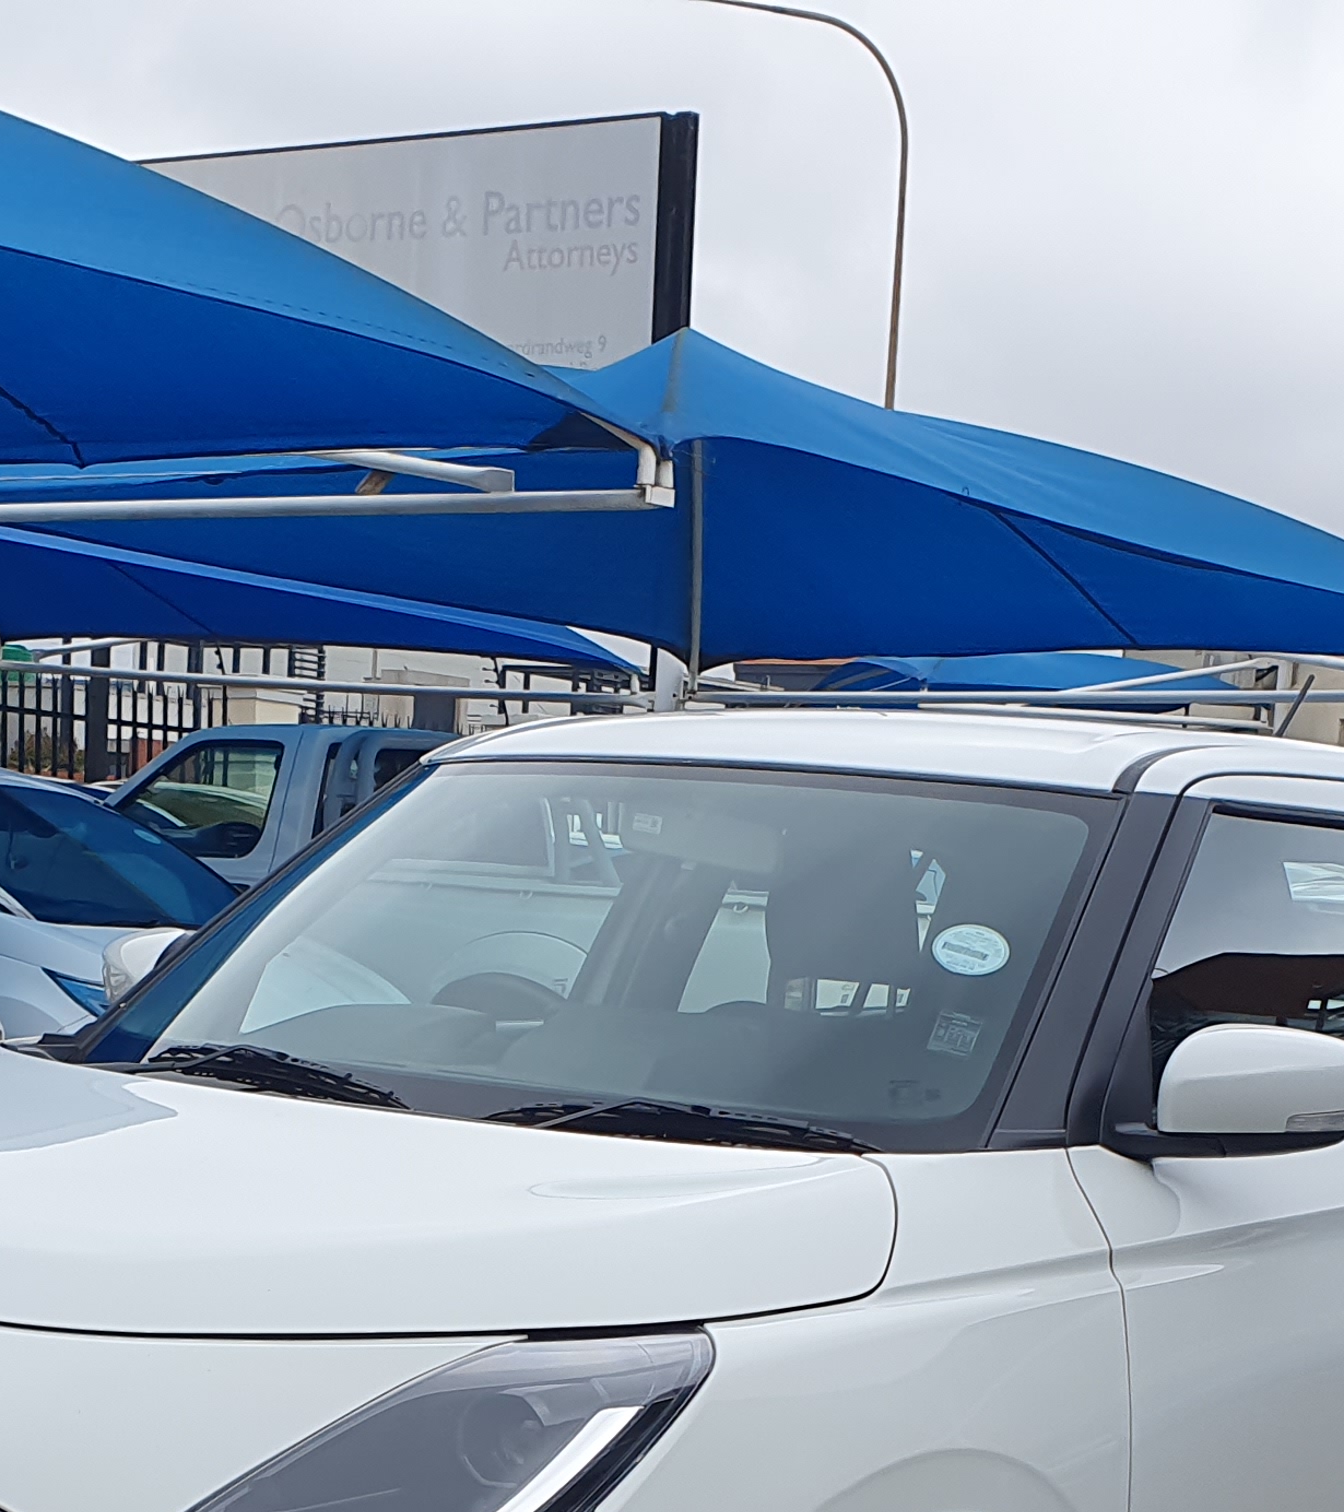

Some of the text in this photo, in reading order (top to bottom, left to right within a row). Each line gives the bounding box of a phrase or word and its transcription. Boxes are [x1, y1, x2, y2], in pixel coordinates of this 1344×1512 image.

[275, 190, 641, 243] Osborne & Partners
[503, 239, 639, 277] Attorneys
